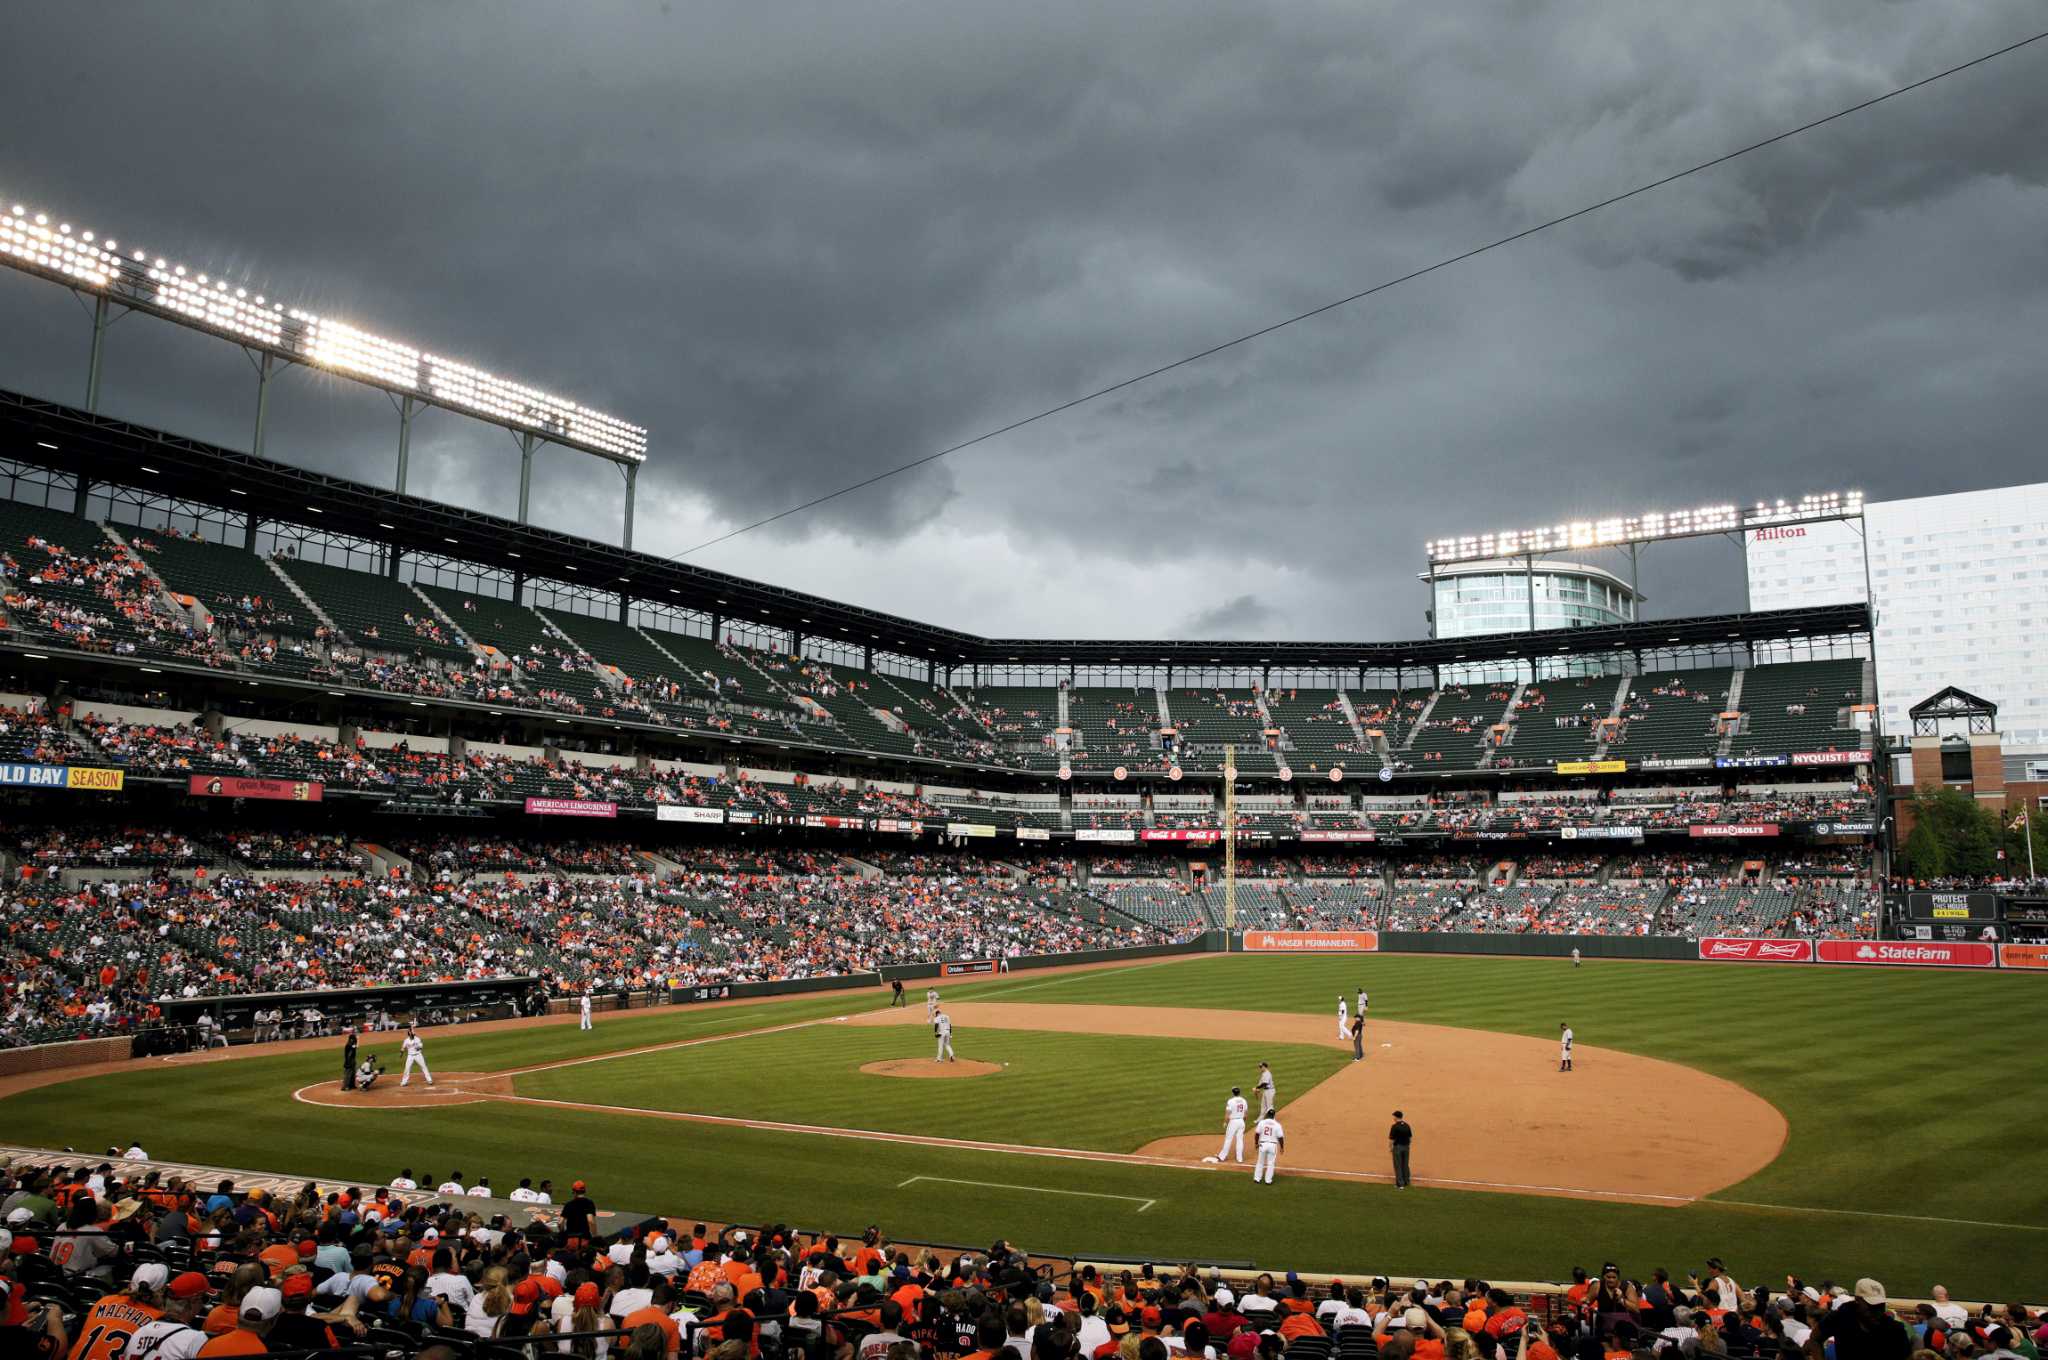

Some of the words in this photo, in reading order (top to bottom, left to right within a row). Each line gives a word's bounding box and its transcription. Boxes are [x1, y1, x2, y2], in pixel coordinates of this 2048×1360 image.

[1756, 528, 1807, 541] Hilton
[0, 766, 25, 782] LD
[72, 770, 119, 786] SEASON
[531, 800, 569, 809] AMERICAN
[570, 802, 612, 811] LIMOUSINES
[694, 811, 722, 819] SHARP
[1610, 826, 1642, 836] UNION
[1932, 894, 1969, 903] PROTECT
[1277, 939, 1303, 947] KAISER
[1236, 1104, 1244, 1112] 19
[1264, 1126, 1273, 1136] 21
[96, 1304, 153, 1326] MACHAD
